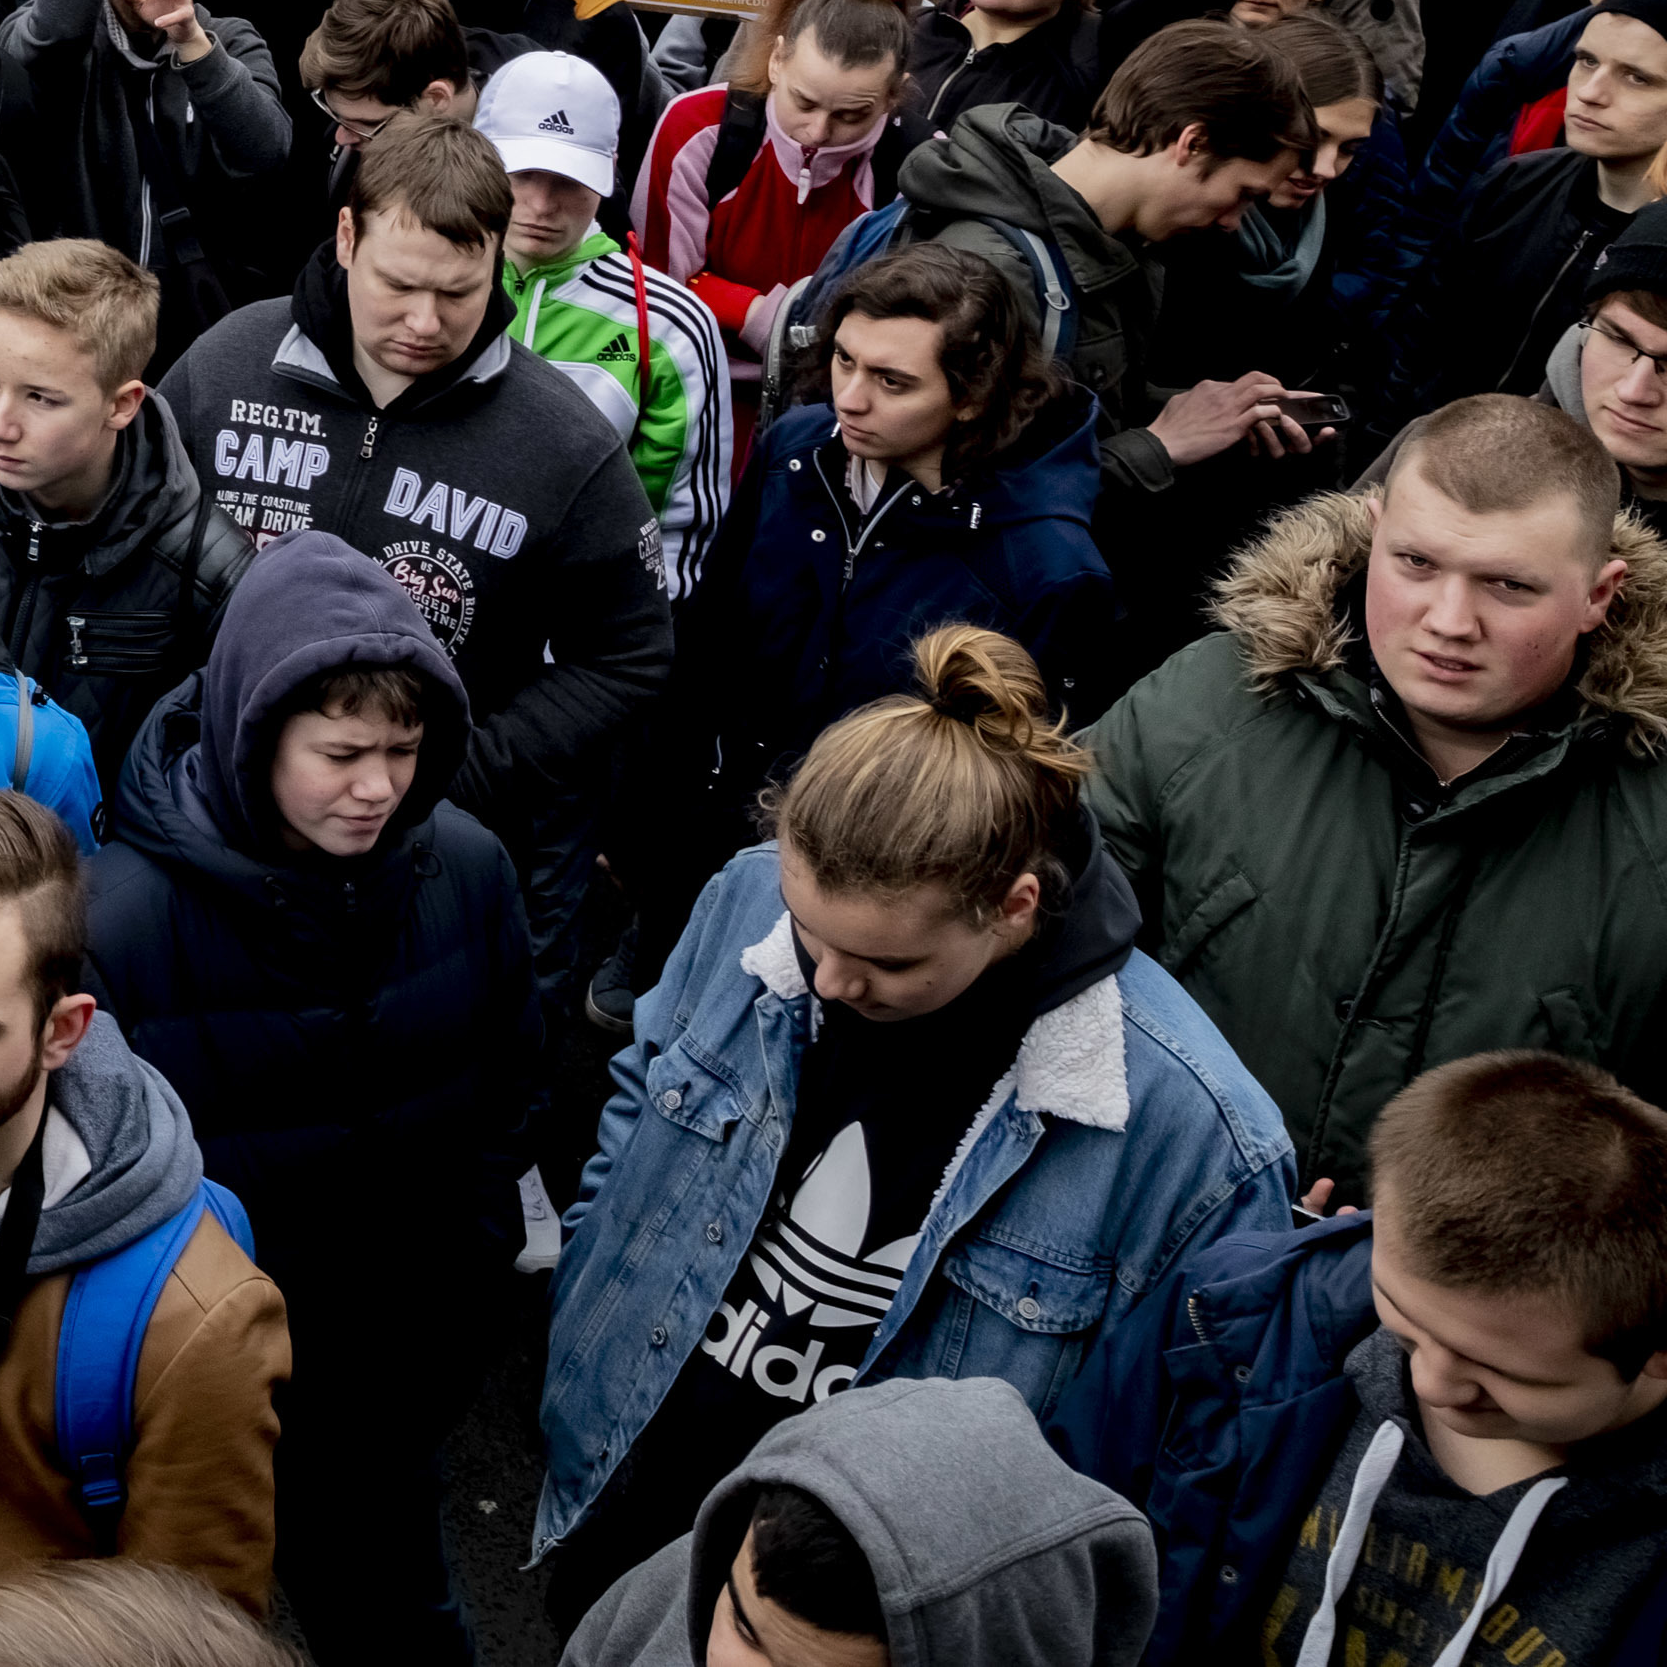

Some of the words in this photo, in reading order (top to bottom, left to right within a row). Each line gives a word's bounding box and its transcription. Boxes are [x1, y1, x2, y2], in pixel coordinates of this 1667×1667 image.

[596, 350, 636, 363] adidas
[229, 398, 327, 438] REG.TM.
[214, 429, 331, 491] CAMP
[382, 466, 529, 560] DAVID
[242, 492, 258, 506] THE
[260, 495, 312, 516] COASTLINE
[392, 560, 427, 597] Big
[428, 574, 462, 604] Sur
[420, 561, 433, 574] US
[382, 540, 431, 560] DRIVE
[435, 546, 474, 592] STATE
[457, 595, 476, 646] ROUTE
